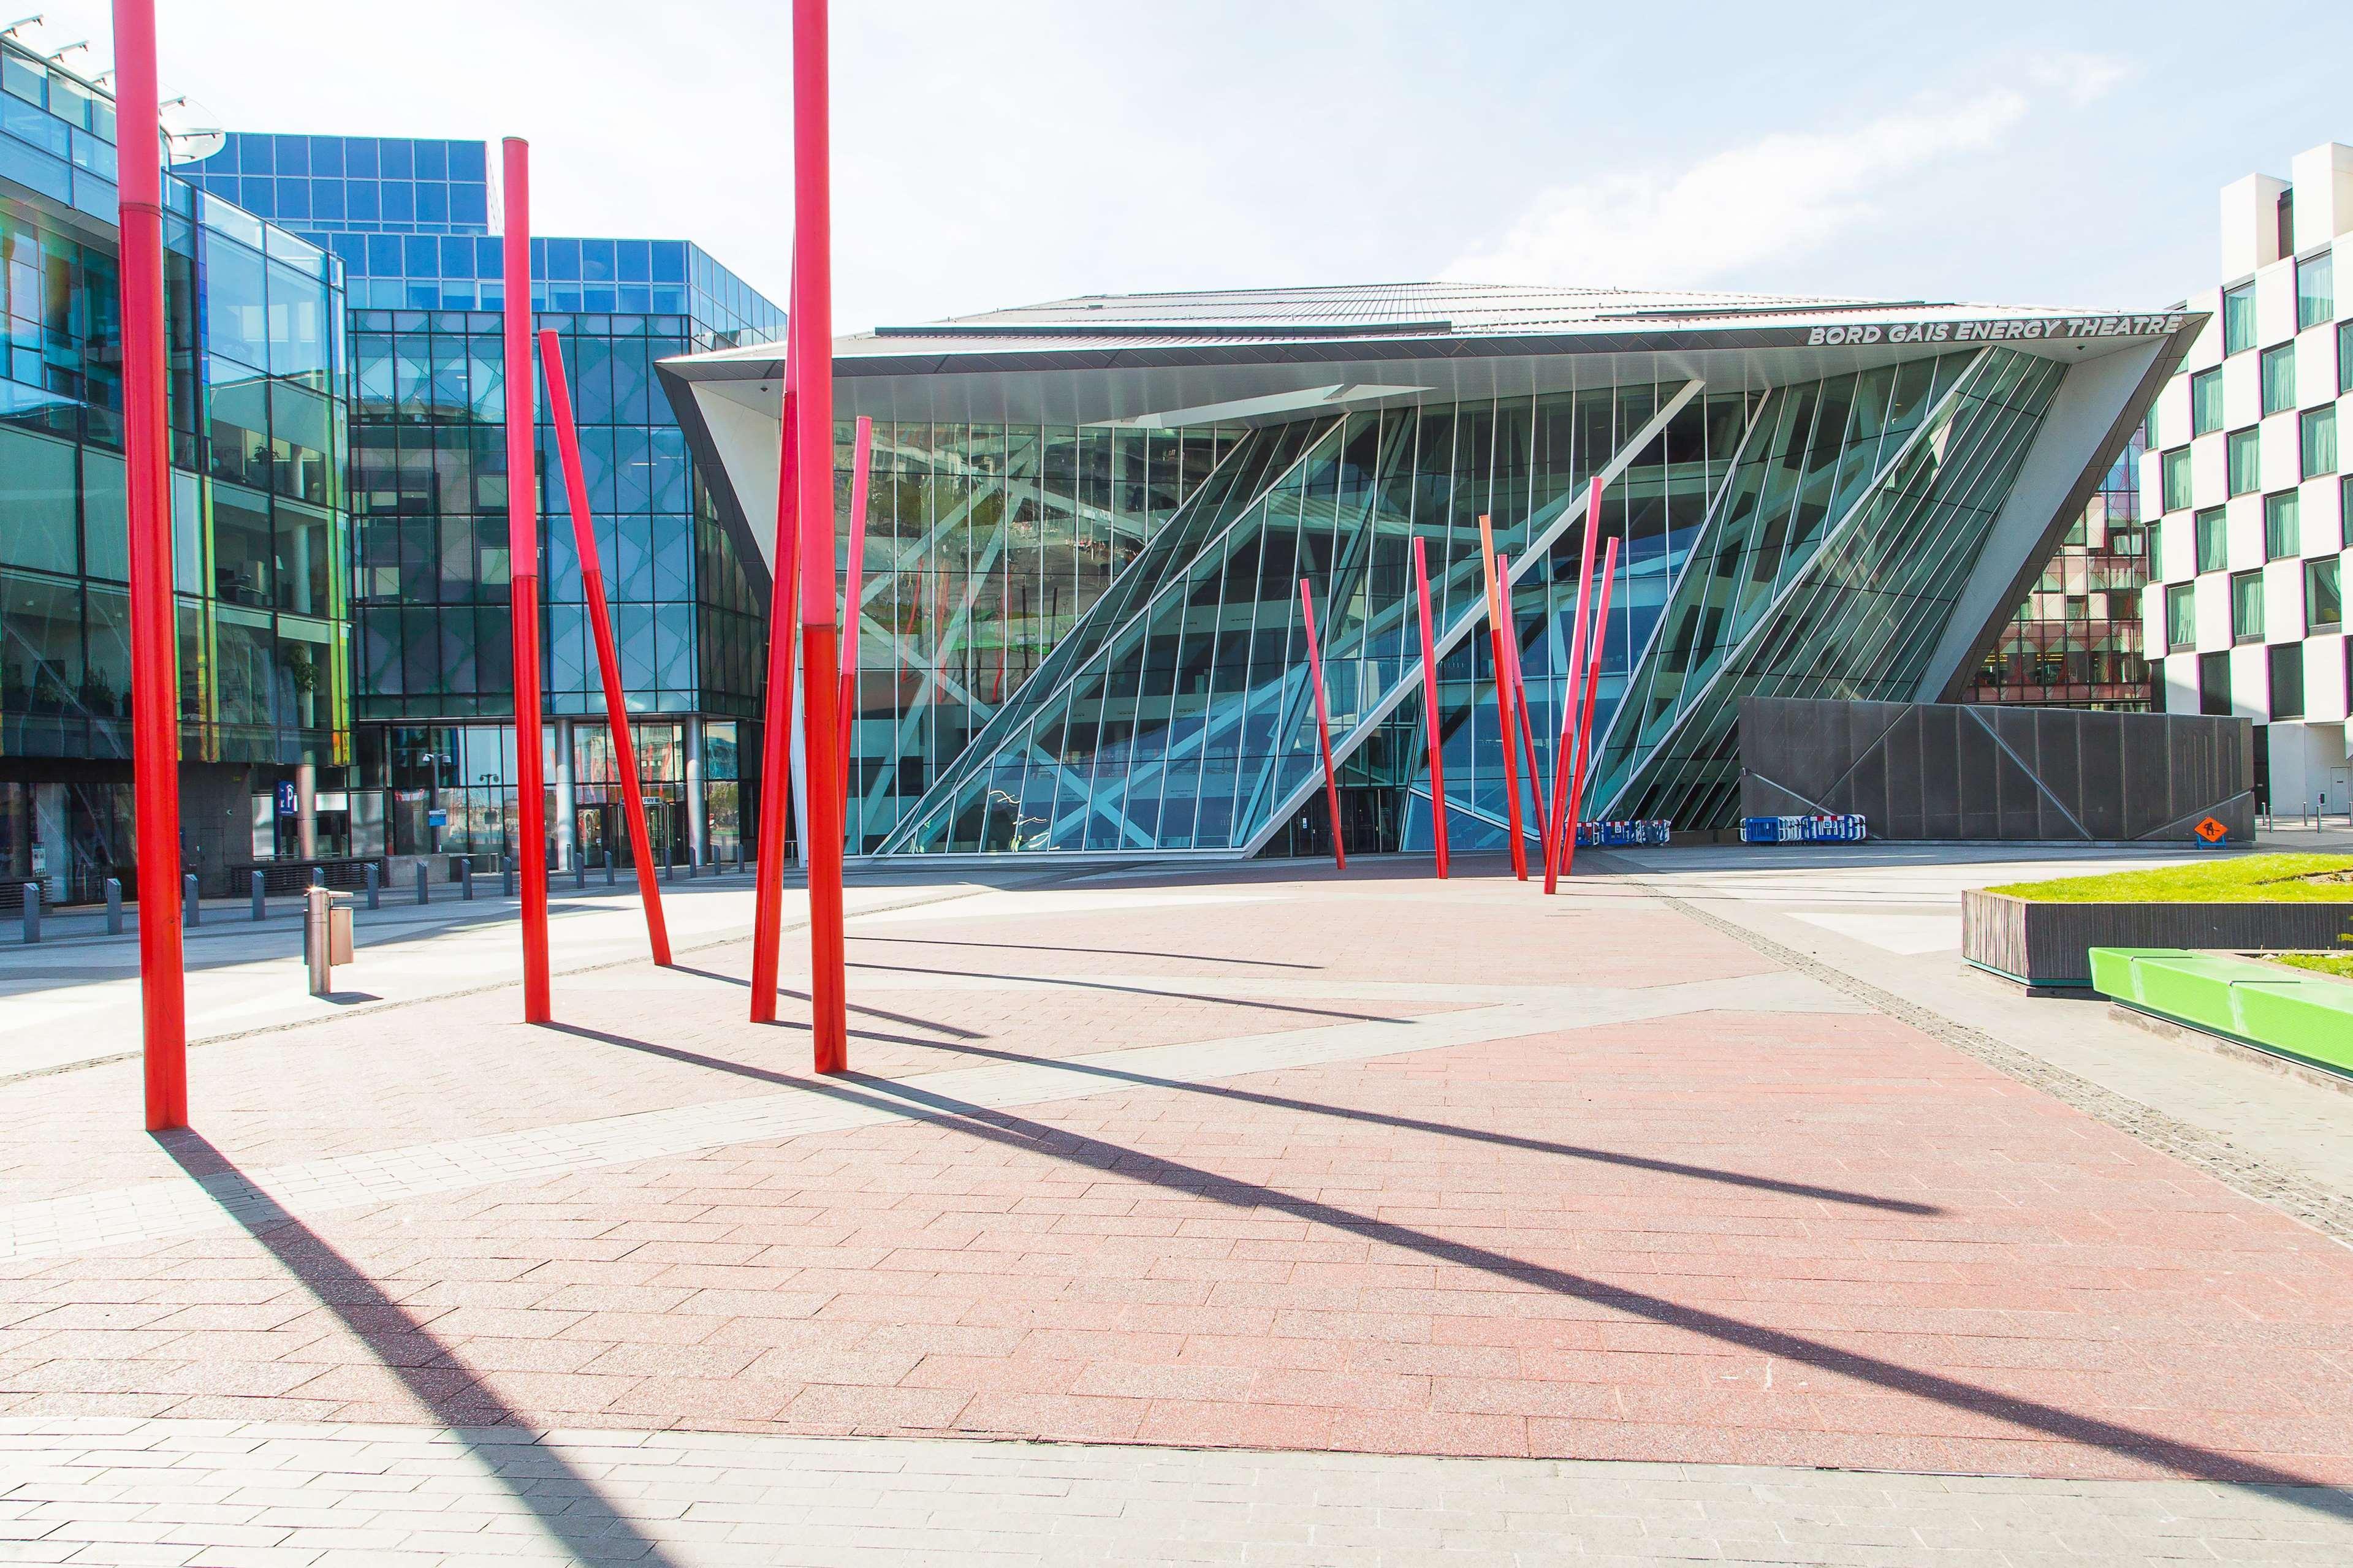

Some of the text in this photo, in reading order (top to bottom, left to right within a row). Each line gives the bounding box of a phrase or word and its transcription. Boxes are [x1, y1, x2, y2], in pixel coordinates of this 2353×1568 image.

[1808, 325, 1881, 346] BORD
[1954, 319, 2062, 341] ENERGY
[2066, 314, 2183, 336] THEATRE
